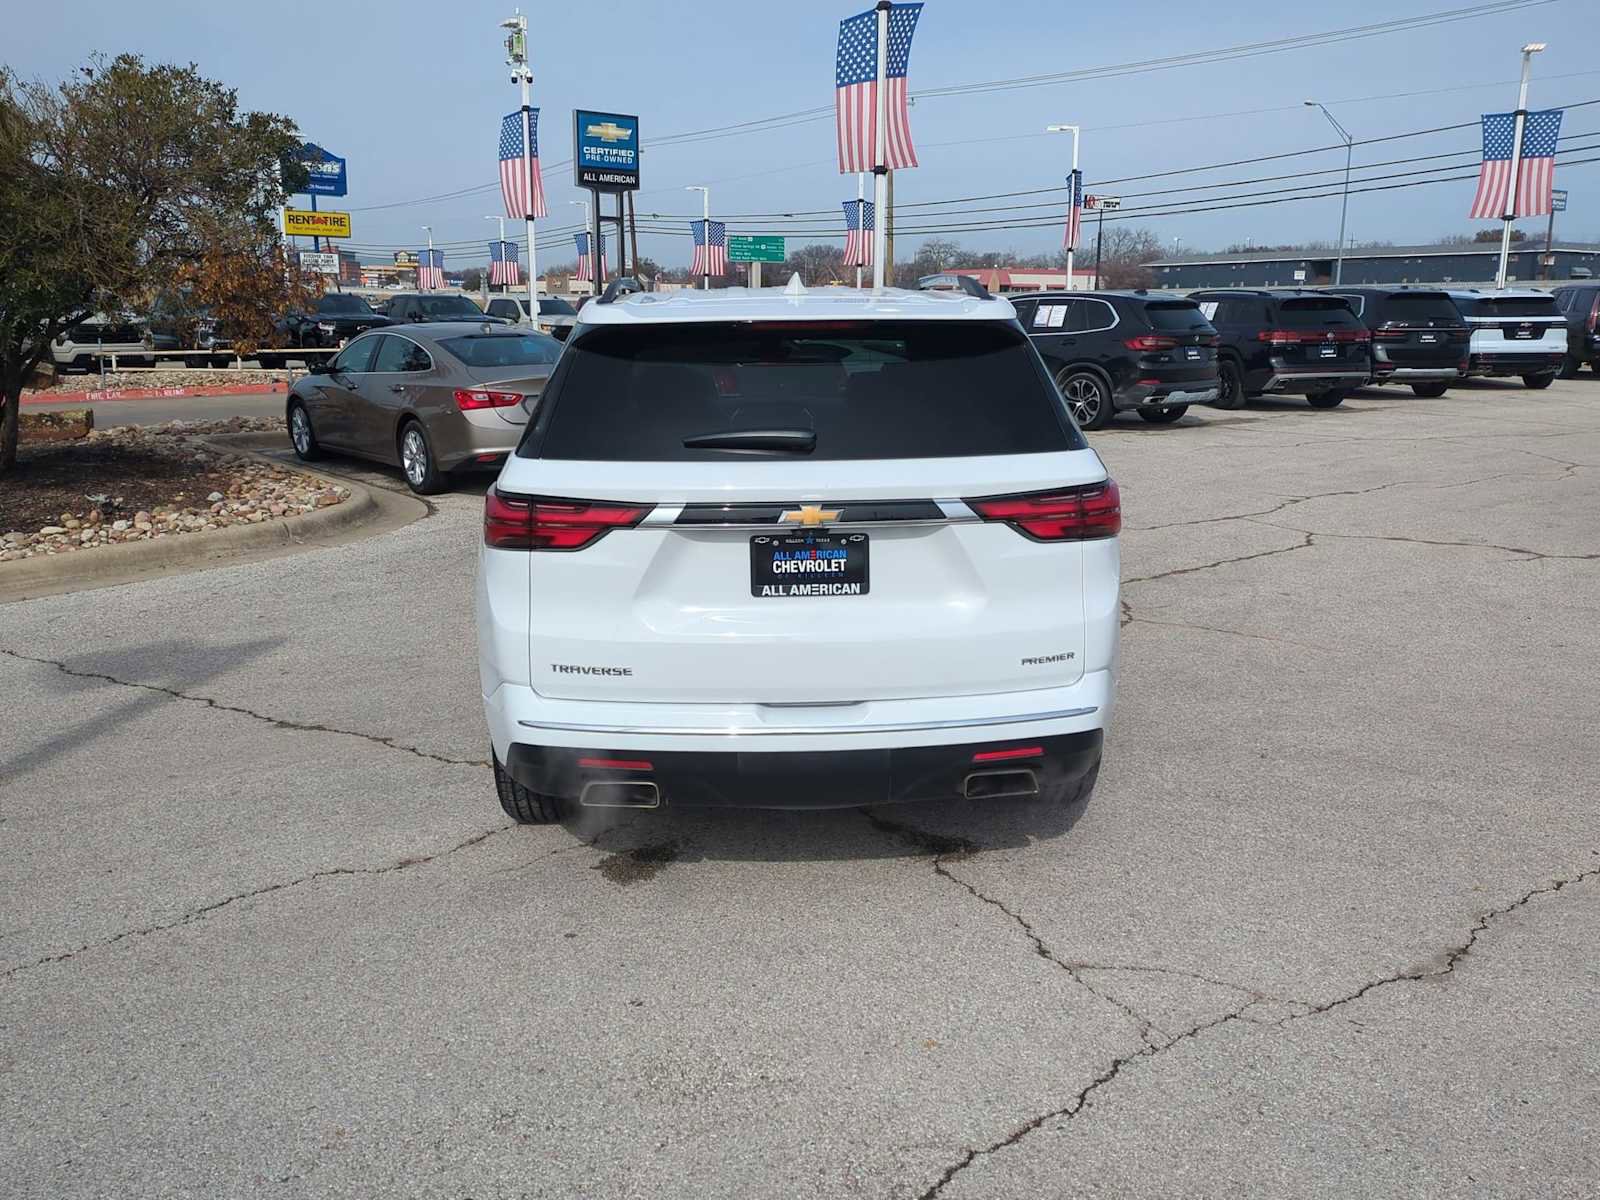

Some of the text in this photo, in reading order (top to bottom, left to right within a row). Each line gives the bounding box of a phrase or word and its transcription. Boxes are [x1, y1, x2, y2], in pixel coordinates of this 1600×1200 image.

[583, 146, 634, 157] CERTIFIED
[585, 154, 633, 164] PRE-OWNED
[583, 172, 636, 184] ALL AMERICAN
[773, 548, 847, 560] ALL AMERICAN
[772, 558, 847, 574] CHEVROLET
[761, 583, 860, 596] ALL AMERICAN
[1021, 652, 1075, 666] PREMIER
[550, 663, 633, 676] TRAVERSE
